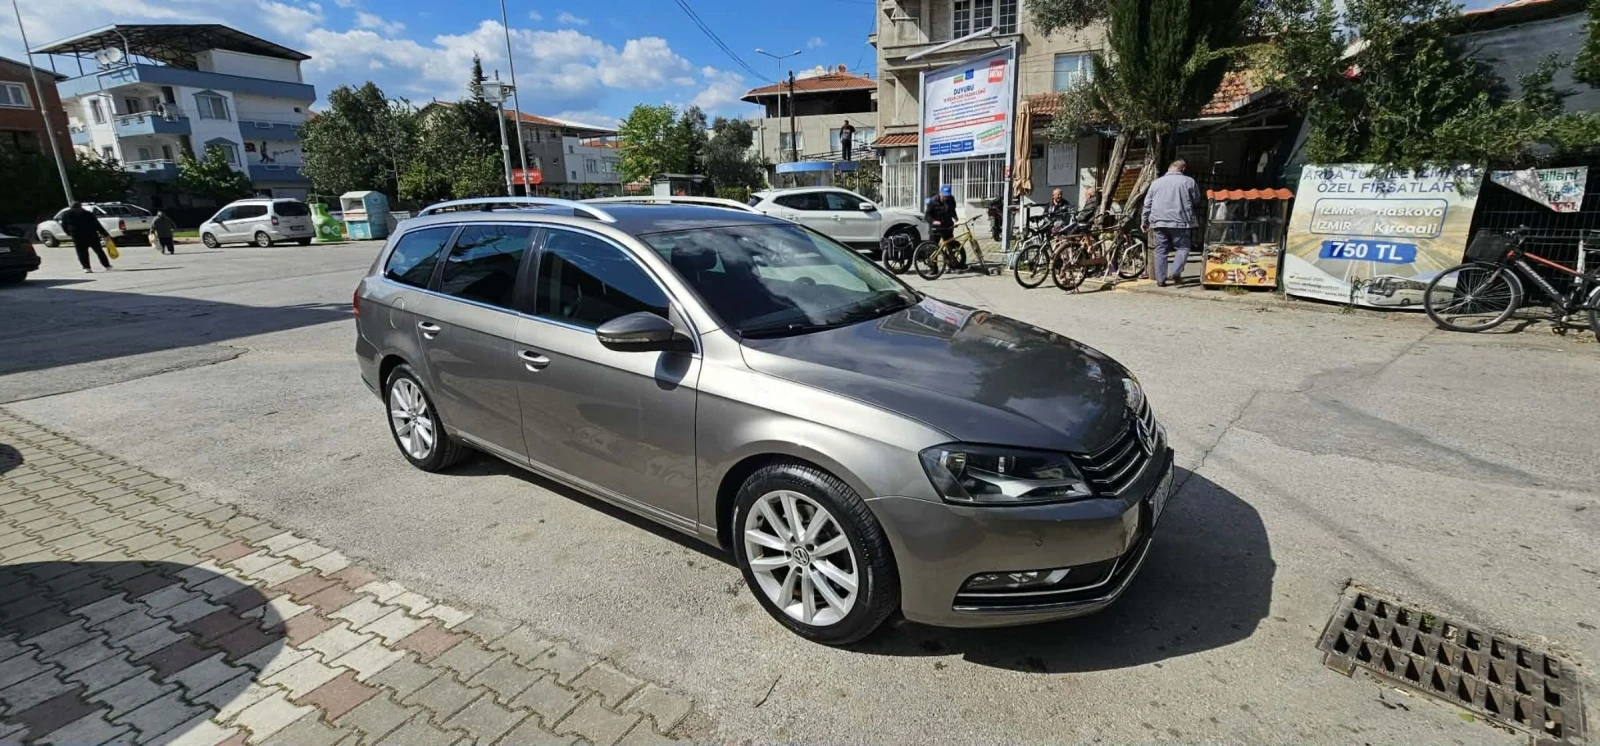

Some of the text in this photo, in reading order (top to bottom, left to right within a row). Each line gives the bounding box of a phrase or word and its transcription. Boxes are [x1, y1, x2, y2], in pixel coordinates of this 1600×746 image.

[953, 84, 975, 95] DUYURU
[1304, 169, 1344, 180] ARDA
[1538, 168, 1581, 182] aillant
[1317, 180, 1454, 193] ÖZEL FIRSATLAR
[1377, 206, 1443, 217] Haskovo
[1331, 242, 1403, 260] 750 TL
